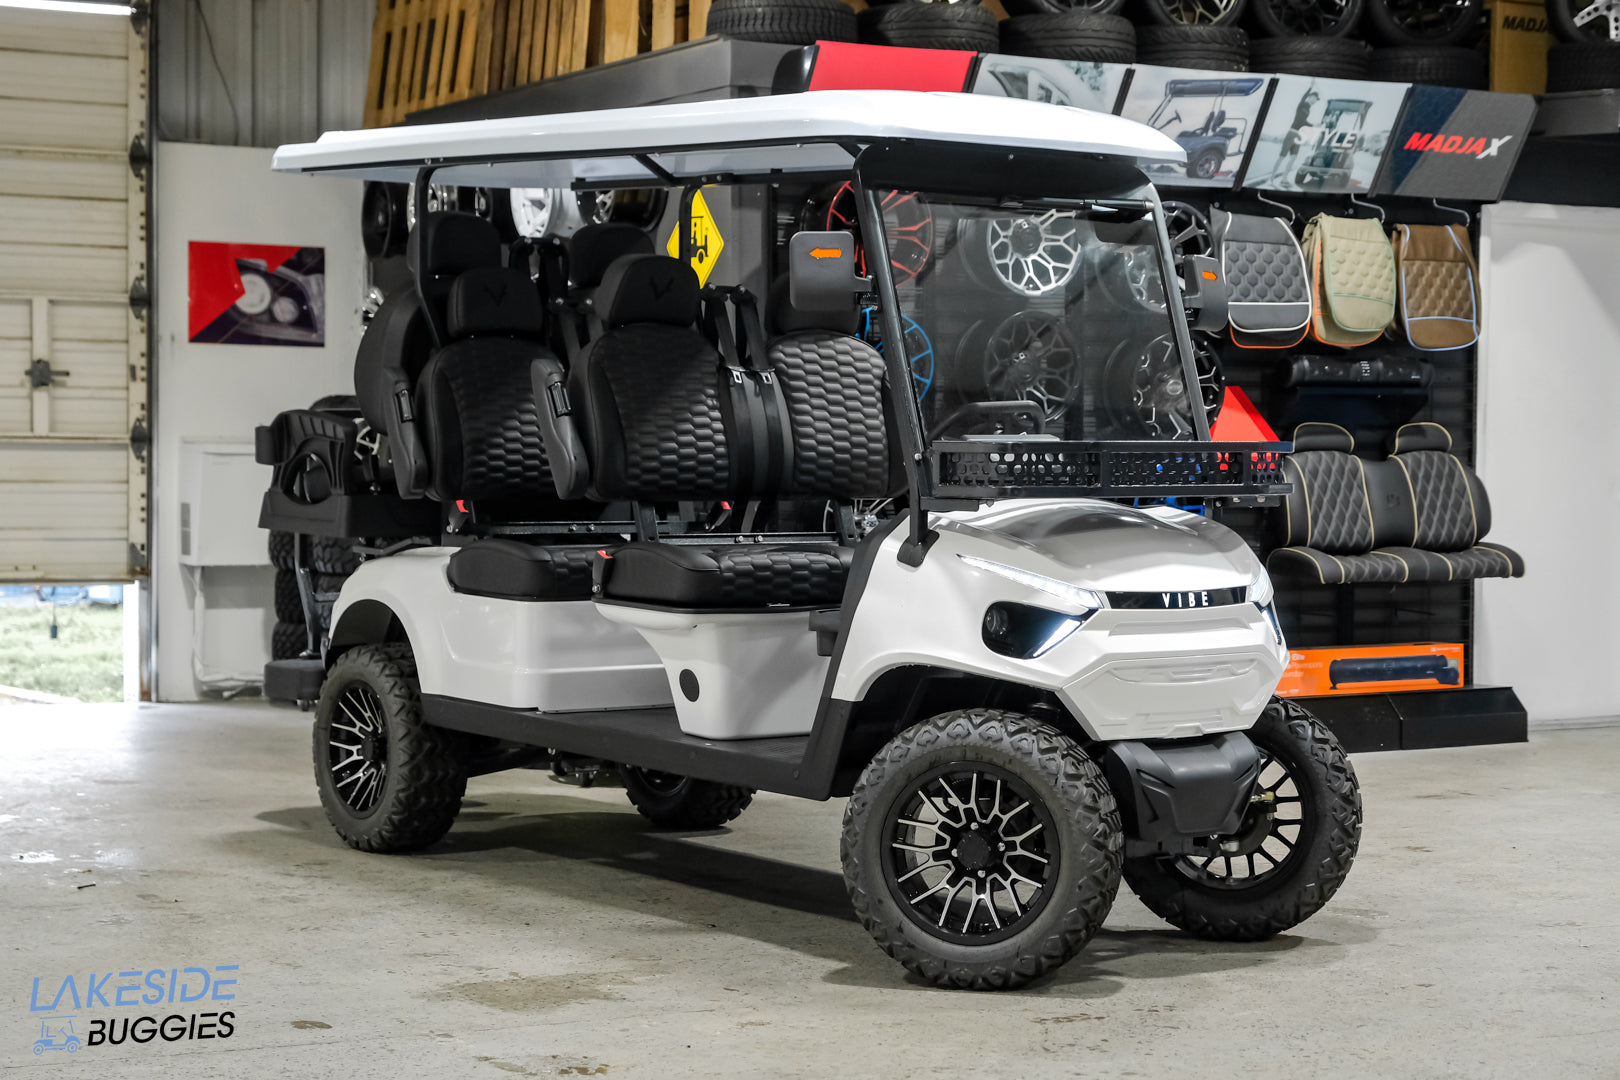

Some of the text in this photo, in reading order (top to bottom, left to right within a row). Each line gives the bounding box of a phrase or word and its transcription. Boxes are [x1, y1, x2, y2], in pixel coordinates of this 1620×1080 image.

[1294, 125, 1358, 148] STYLE
[1403, 132, 1513, 159] MADJAX
[1162, 591, 1209, 608] VIBE
